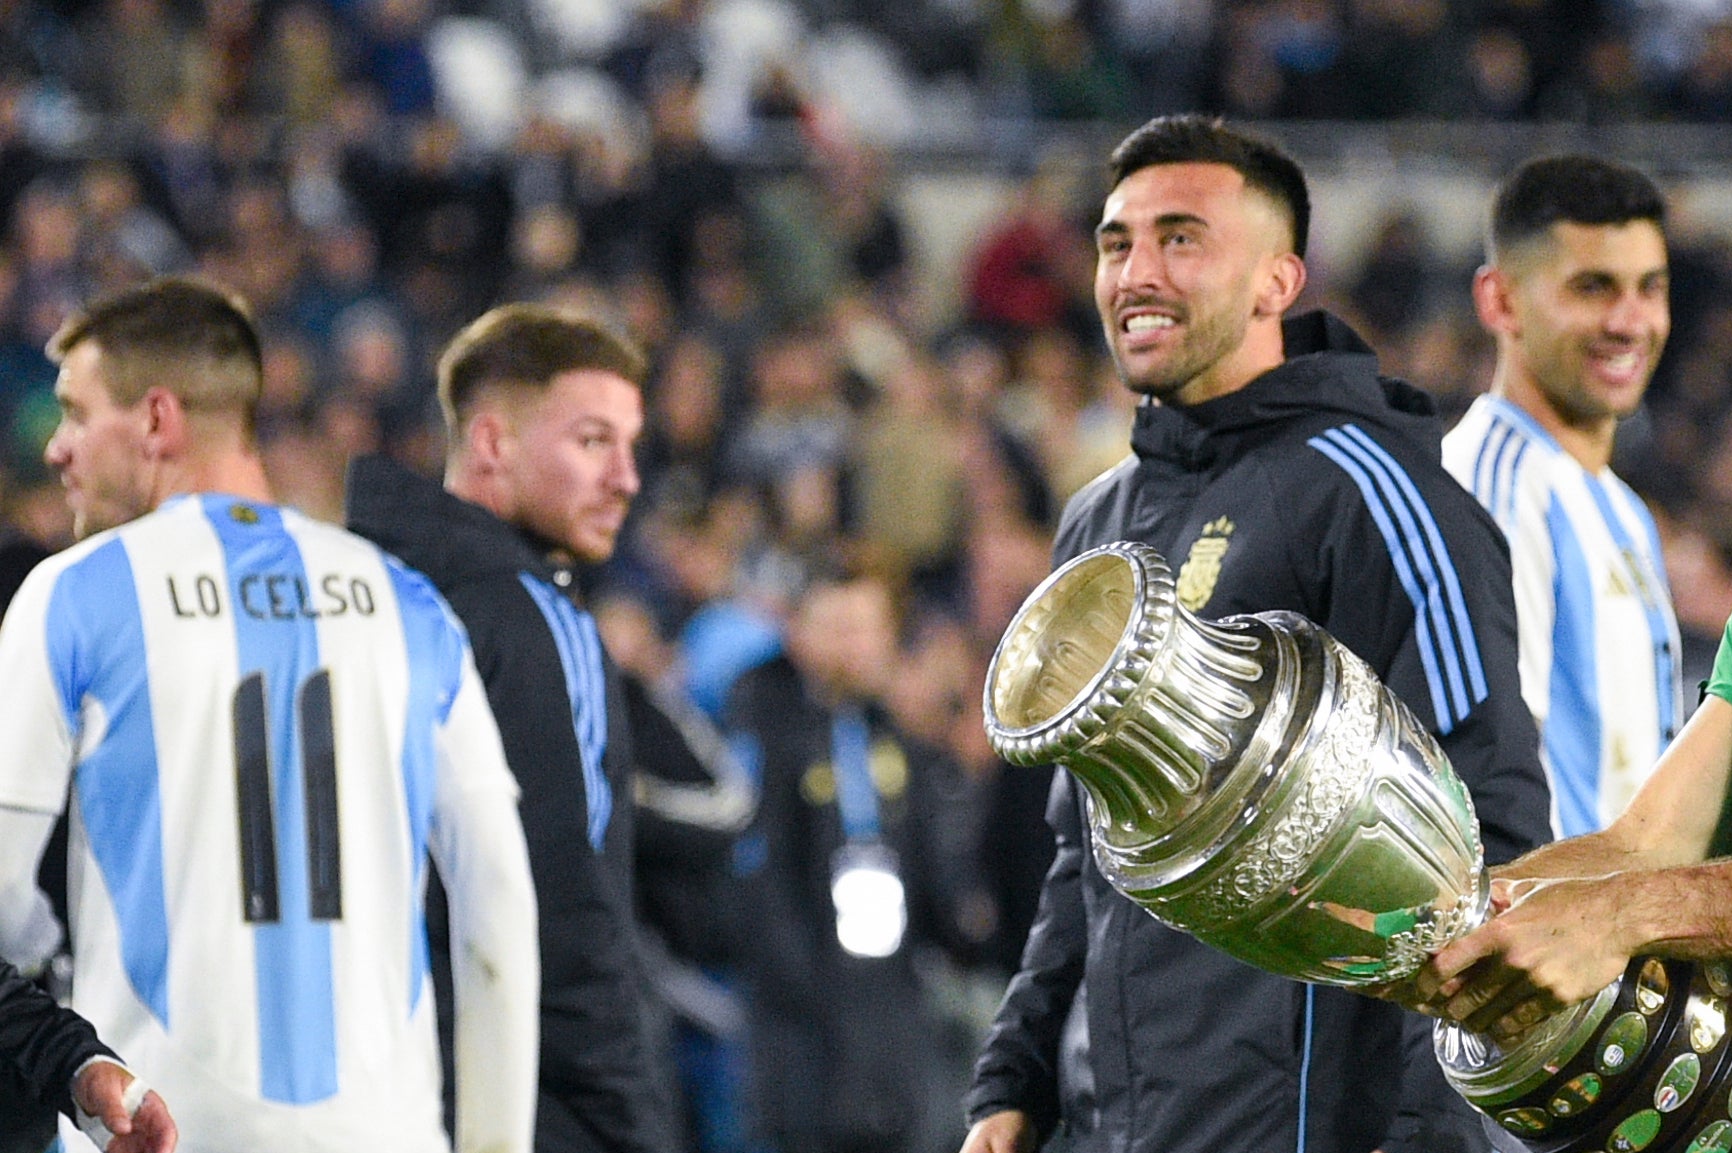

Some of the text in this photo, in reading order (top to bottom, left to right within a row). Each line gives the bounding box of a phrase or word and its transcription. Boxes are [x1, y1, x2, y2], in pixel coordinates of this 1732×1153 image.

[167, 574, 375, 619] LO CELSO
[232, 669, 343, 923] 11
